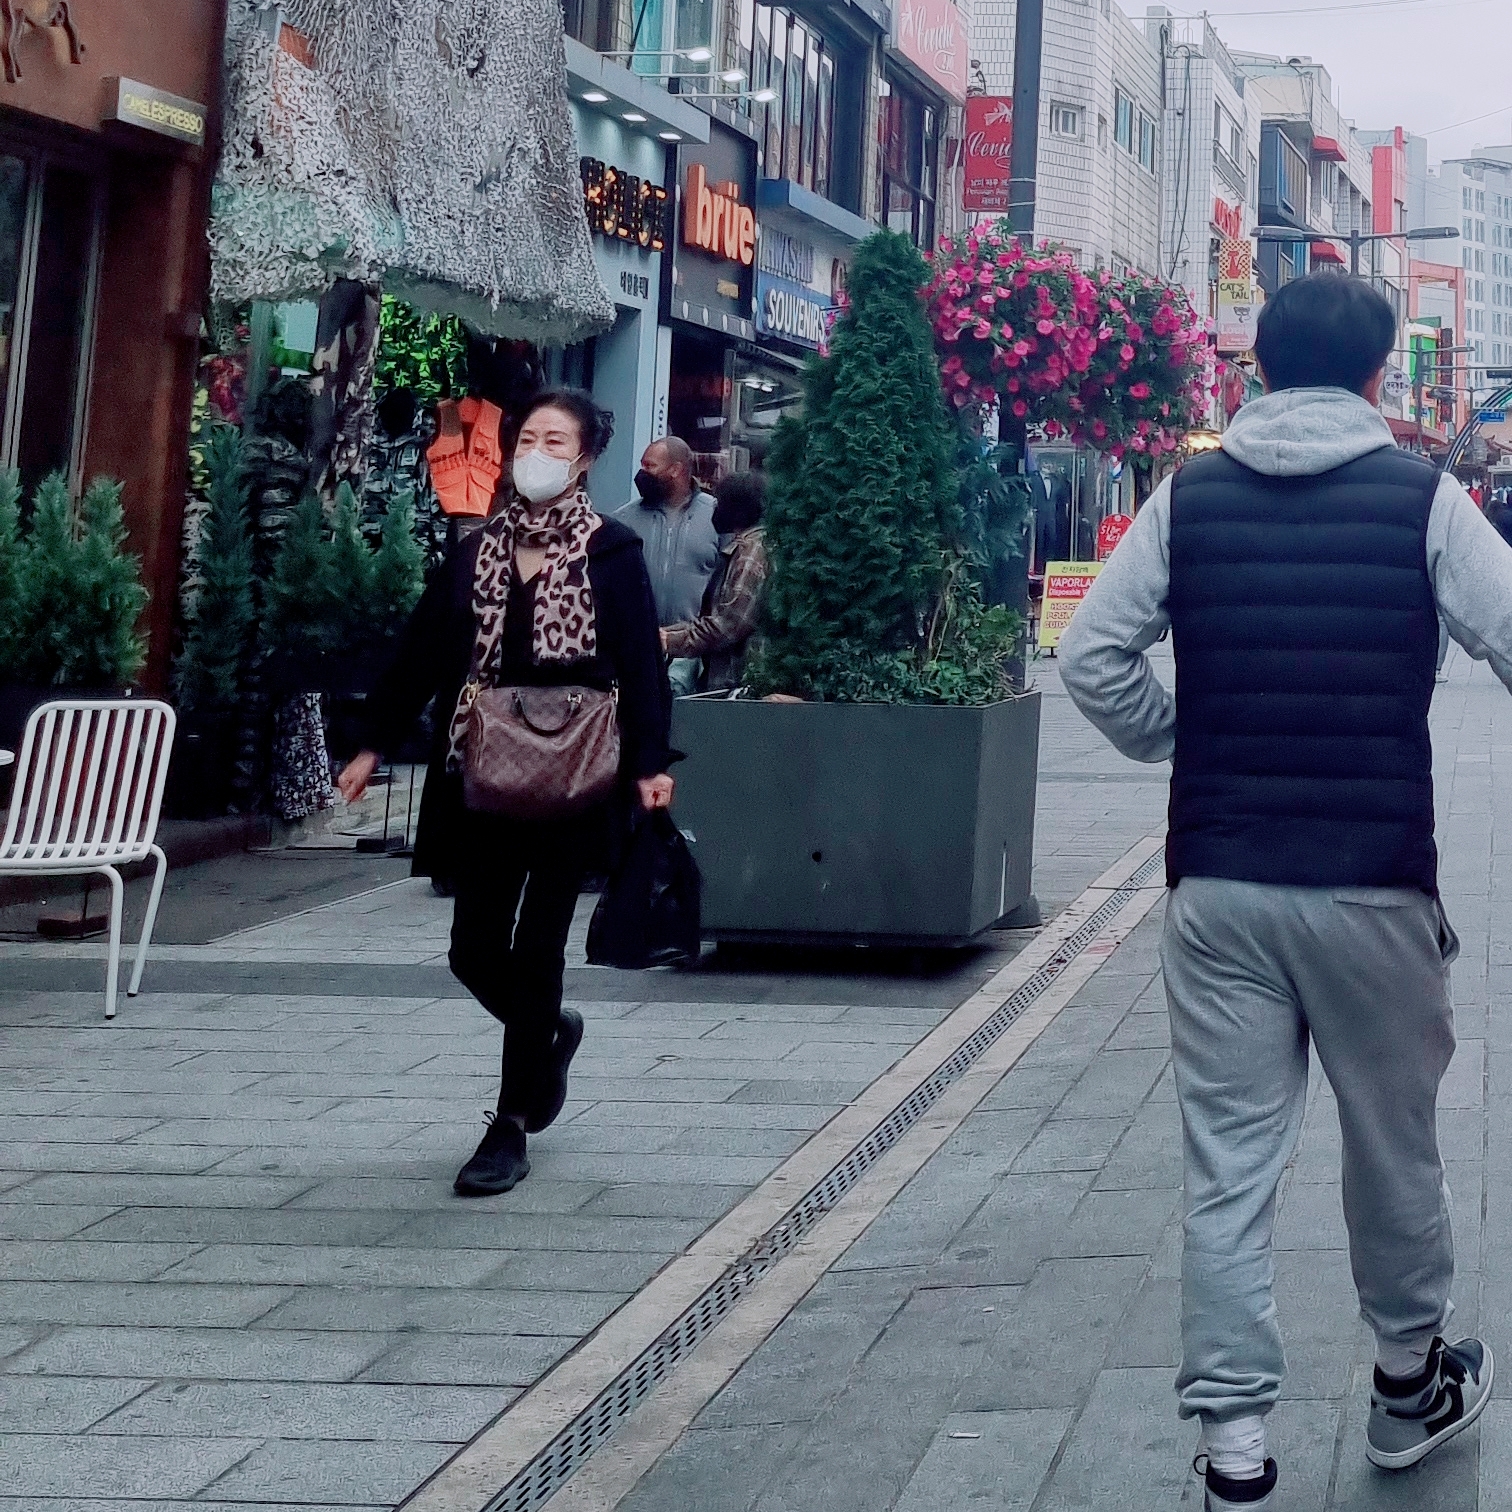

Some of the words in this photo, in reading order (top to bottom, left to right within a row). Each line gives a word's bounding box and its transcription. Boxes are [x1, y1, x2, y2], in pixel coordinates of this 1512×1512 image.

[685, 162, 756, 266] brüe
[1220, 282, 1245, 292] CAT'S
[1231, 290, 1249, 300] TAIL
[767, 288, 827, 343] SOUVENIRS
